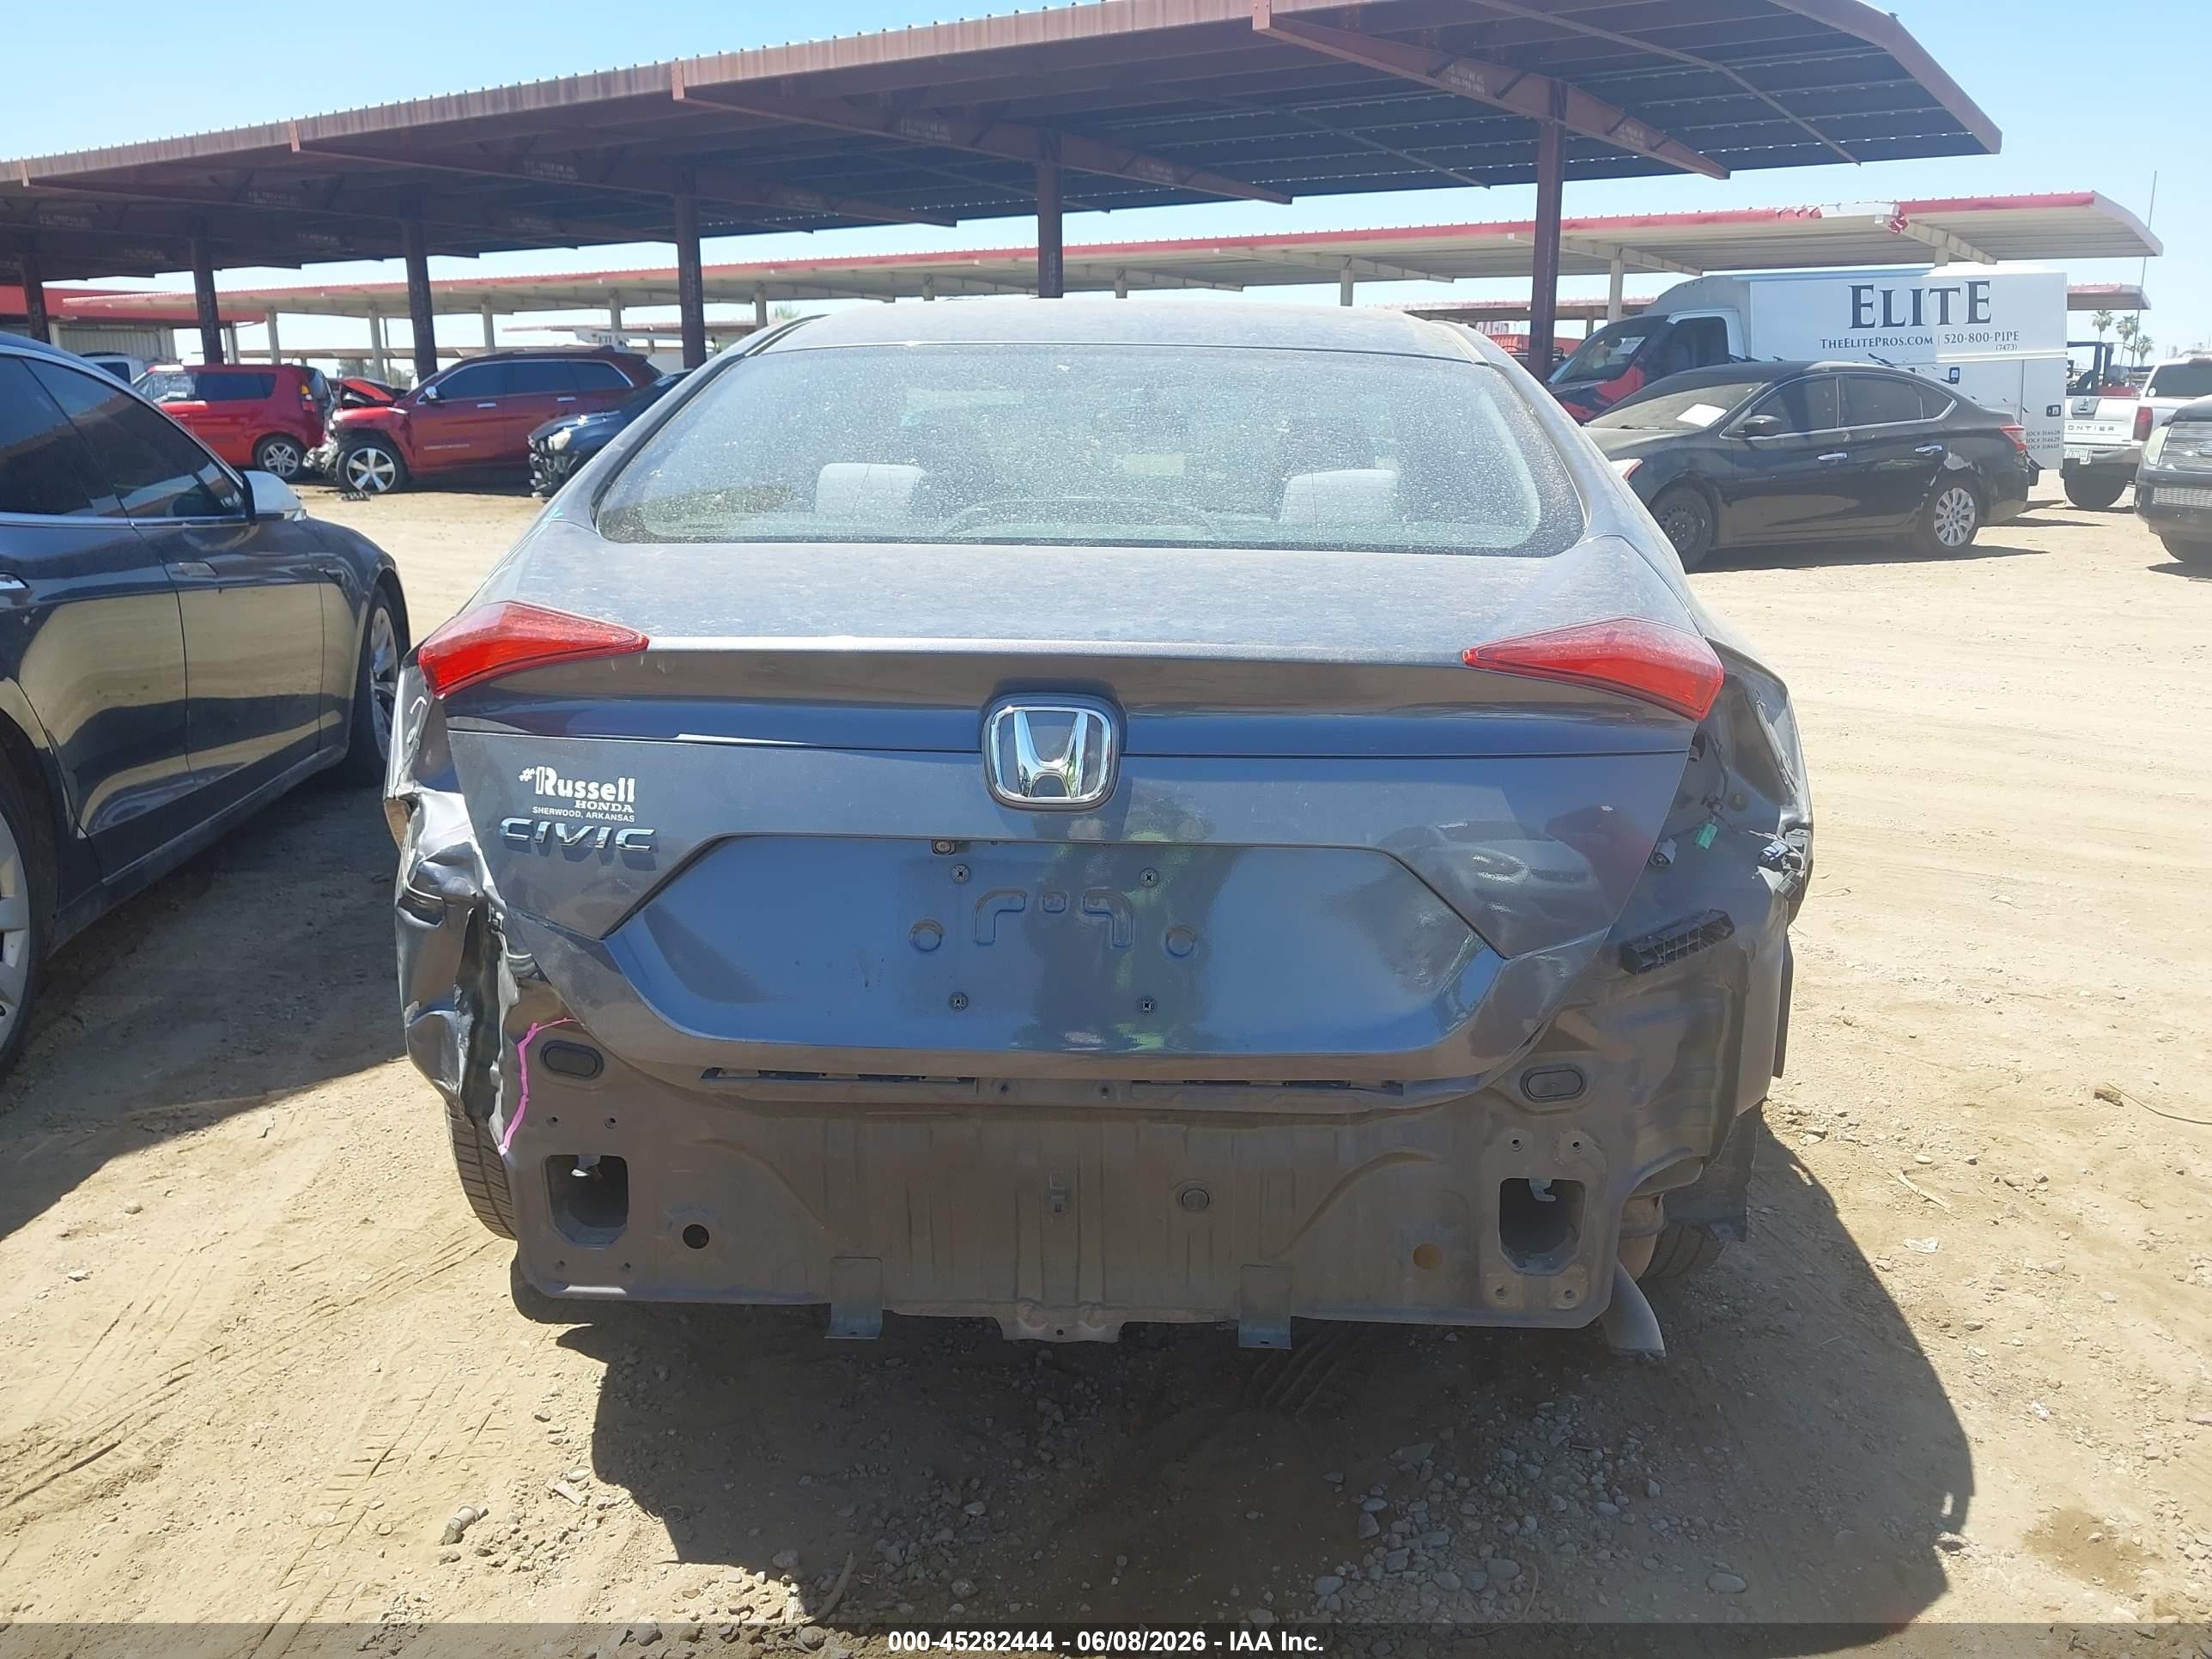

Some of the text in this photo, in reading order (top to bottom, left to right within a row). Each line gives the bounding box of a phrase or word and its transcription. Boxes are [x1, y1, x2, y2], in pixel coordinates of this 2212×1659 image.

[1848, 280, 1992, 329] ELITE
[1943, 331, 2020, 344] 520-800-PIPE
[532, 805, 635, 823] SHERWOOD, ARKANSAS
[574, 799, 635, 813] HONDA
[500, 817, 656, 853] CIVIC
